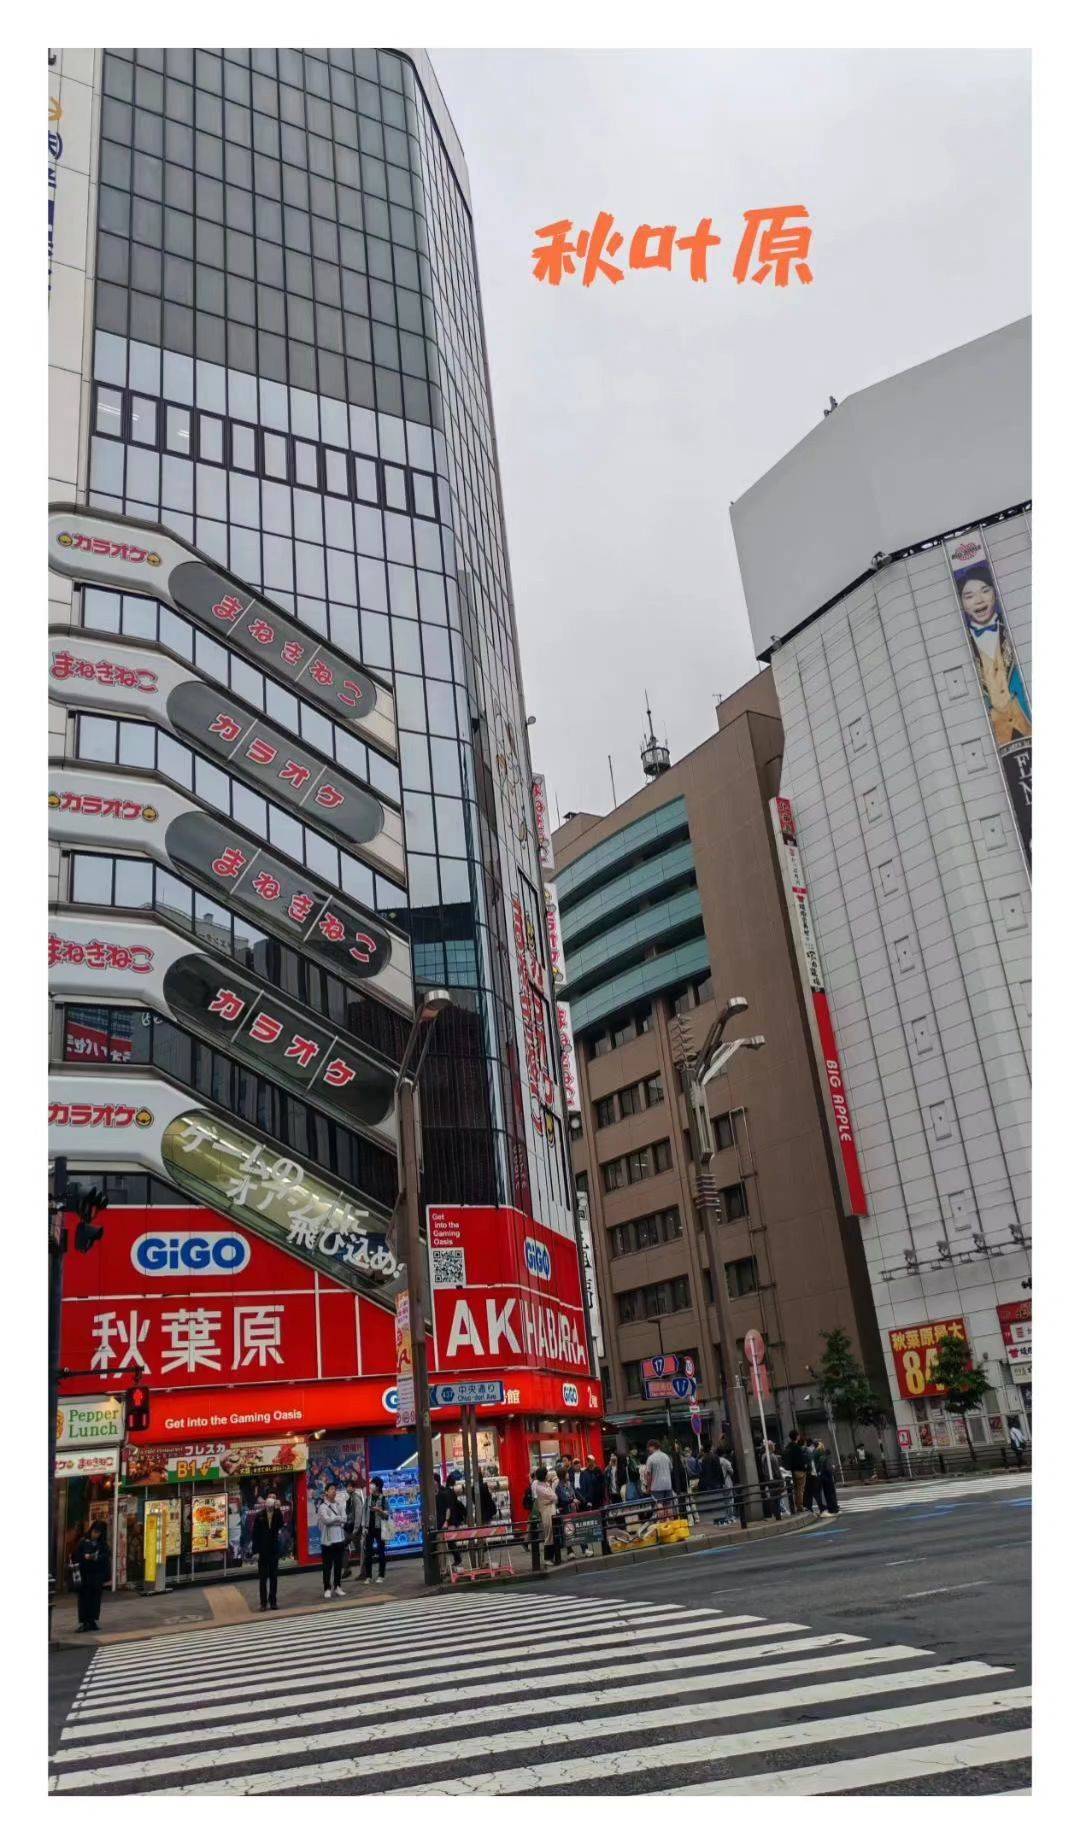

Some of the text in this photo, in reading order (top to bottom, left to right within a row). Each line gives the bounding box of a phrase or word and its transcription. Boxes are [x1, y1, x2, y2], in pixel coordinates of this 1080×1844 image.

[71, 533, 149, 563] カラオケ
[211, 595, 363, 708] まねきねこ
[50, 650, 159, 694] まねきねこ
[207, 713, 345, 809] カラオケ
[59, 791, 144, 821] カラオケ
[211, 848, 377, 964] まねきねこ
[208, 988, 356, 1088] カラオケ
[48, 1104, 137, 1127] カラオケ
[826, 1060, 852, 1142] BIG APPLE
[433, 1230, 461, 1239] Gaming
[433, 1238, 453, 1246] Oasis
[136, 1238, 246, 1270] GiGO
[526, 1242, 550, 1279] GiGO
[91, 1305, 285, 1379] 秋葉原
[458, 1384, 495, 1394] 中央通り
[68, 1422, 118, 1438] Lunch
[69, 1408, 119, 1423] Pepper
[165, 1409, 303, 1429] Get into the Gaming Oasis
[177, 1459, 196, 1478] B1
